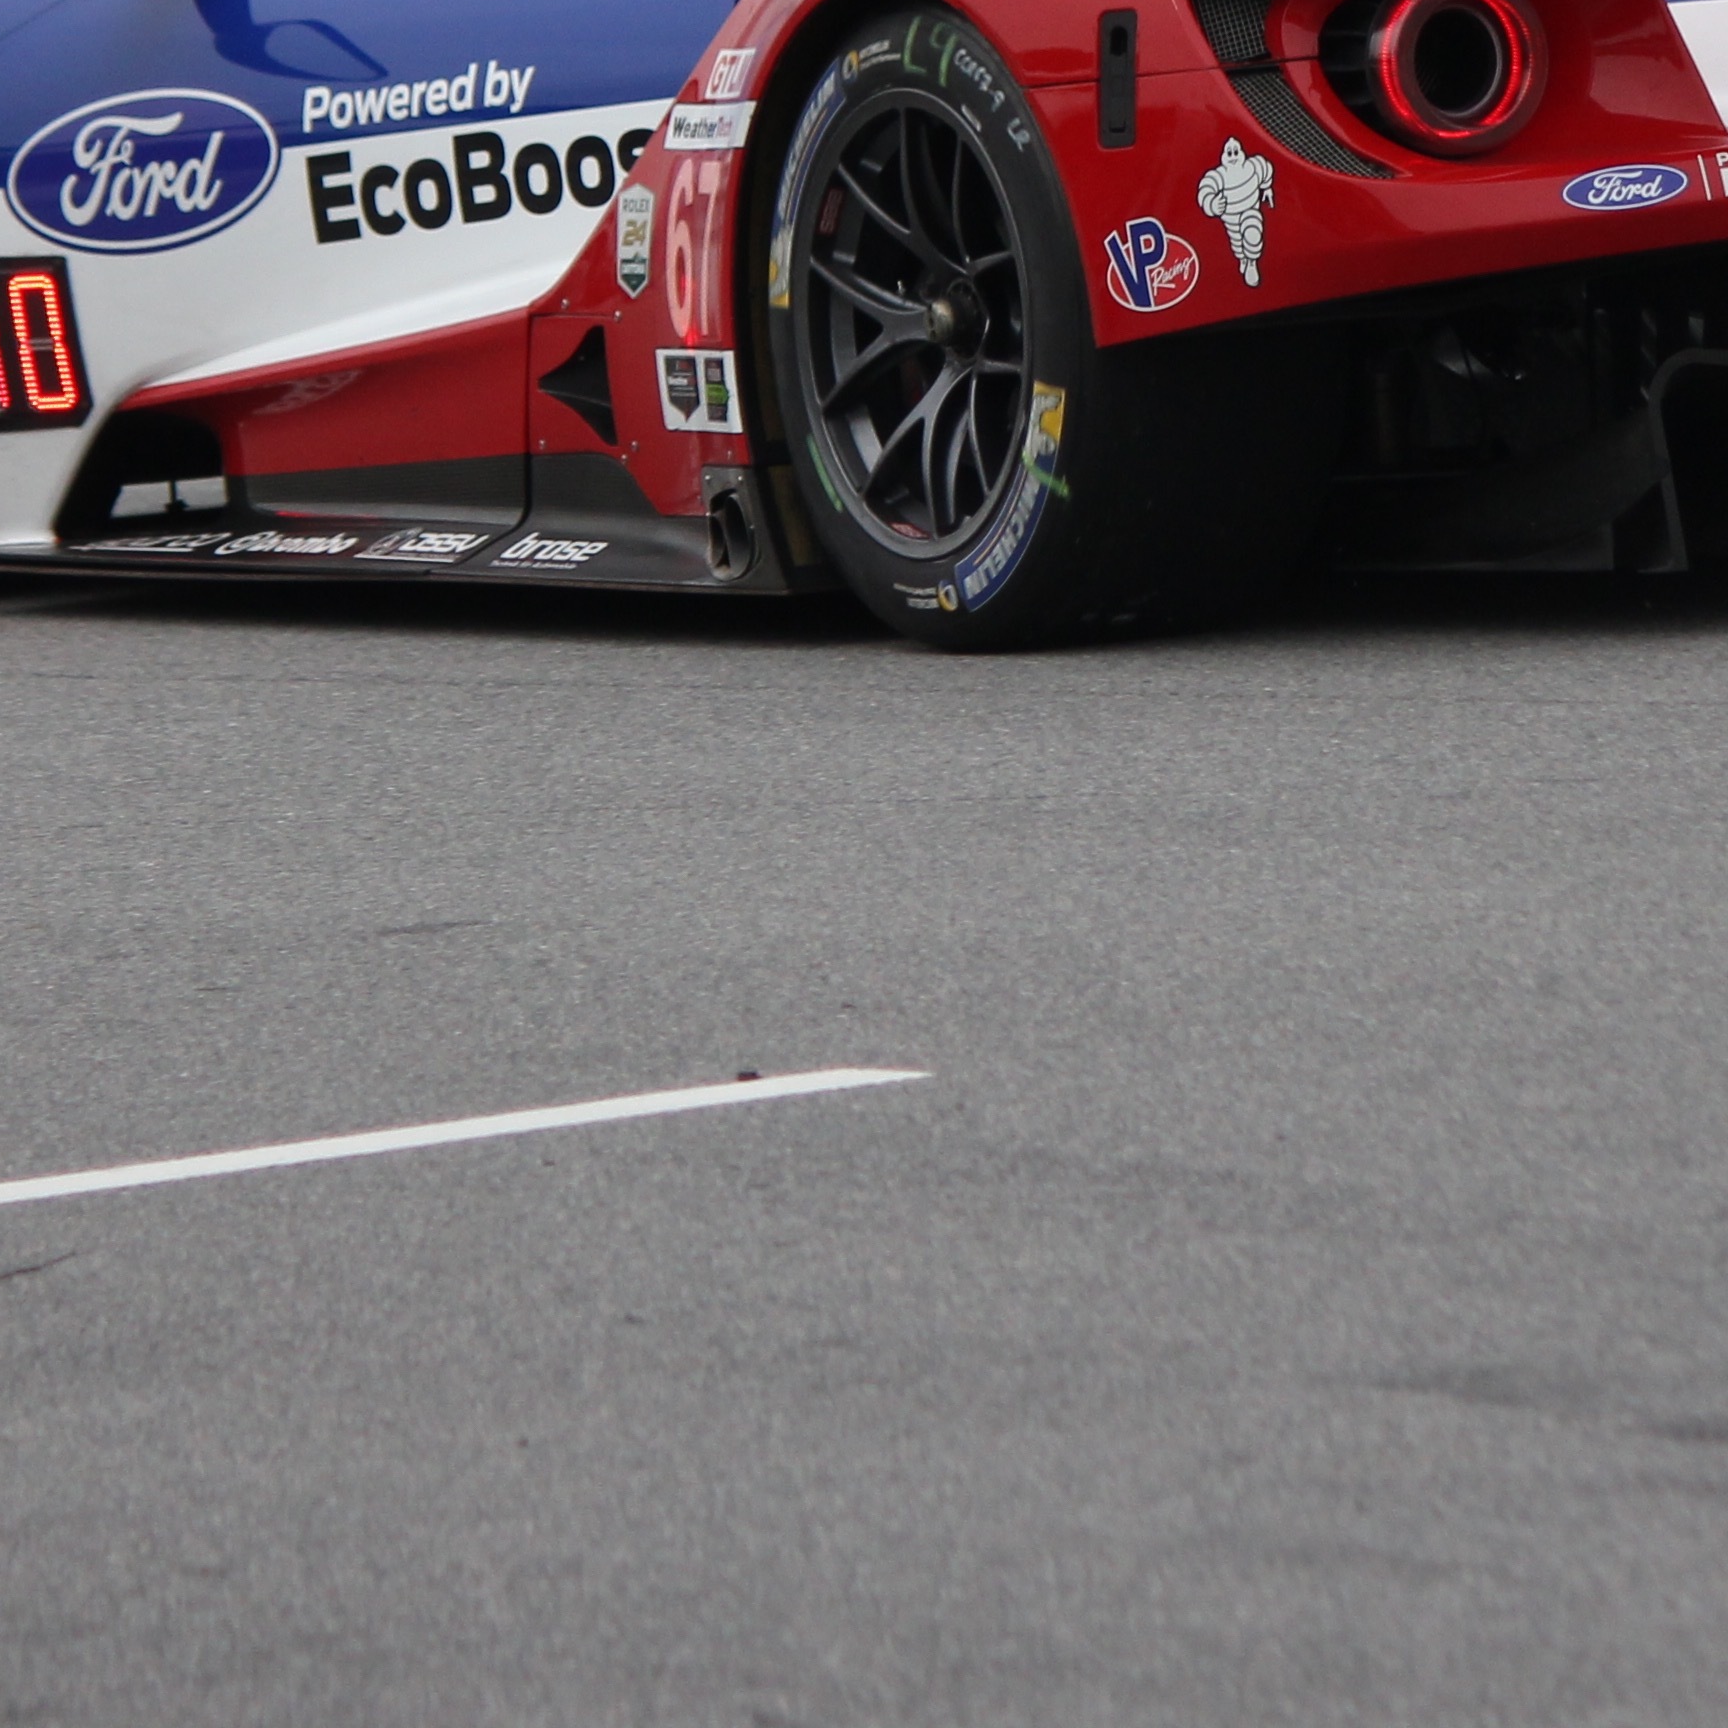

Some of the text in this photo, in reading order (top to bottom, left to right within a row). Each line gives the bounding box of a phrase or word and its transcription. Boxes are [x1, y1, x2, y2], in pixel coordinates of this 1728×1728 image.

[302, 60, 536, 133] Powered by
[60, 112, 224, 227] Ford
[1587, 170, 1663, 205] Ford
[666, 158, 721, 339] 67
[1103, 216, 1168, 311] VP
[500, 532, 609, 562] brose
